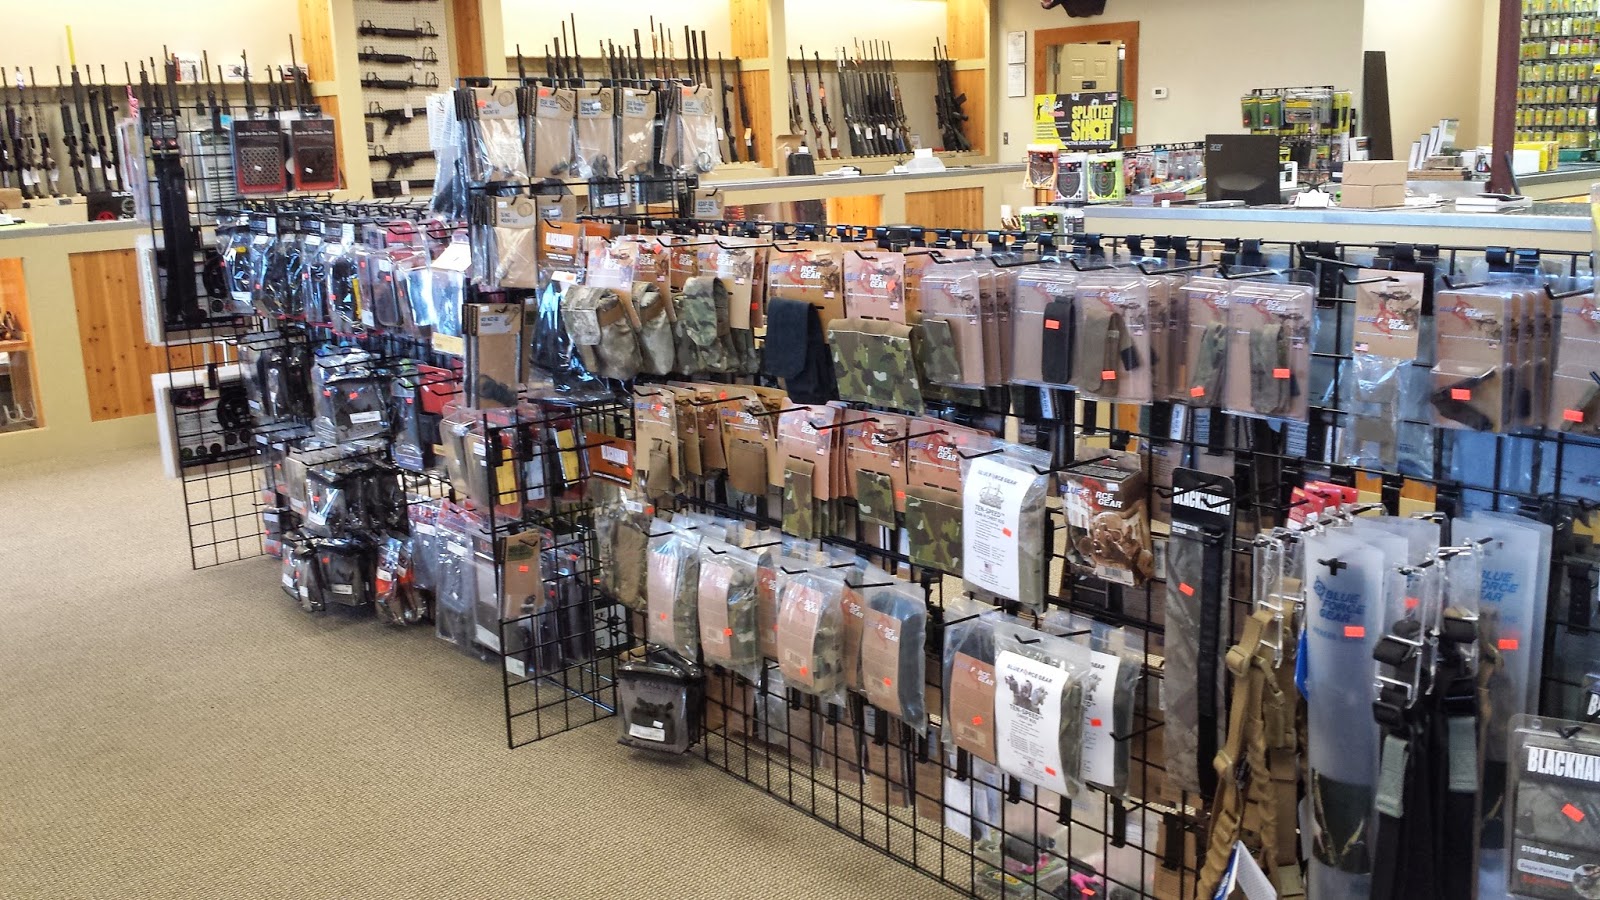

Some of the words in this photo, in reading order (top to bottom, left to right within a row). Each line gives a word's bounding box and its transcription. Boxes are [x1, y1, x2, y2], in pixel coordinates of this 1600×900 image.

[1071, 119, 1114, 141] SHOT
[1209, 142, 1223, 151] acer
[801, 271, 821, 279] GEAR
[1388, 323, 1411, 331] GEAR
[800, 427, 818, 436] GEAR
[936, 452, 957, 462] GEAR
[1060, 484, 1081, 496] BLUE
[1097, 498, 1124, 509] GEAR
[1481, 580, 1519, 593] ORCE
[1325, 589, 1361, 603] BLUE
[1322, 599, 1366, 615] FORCE
[1320, 608, 1352, 622] GEAR
[1521, 845, 1548, 856] STORM
